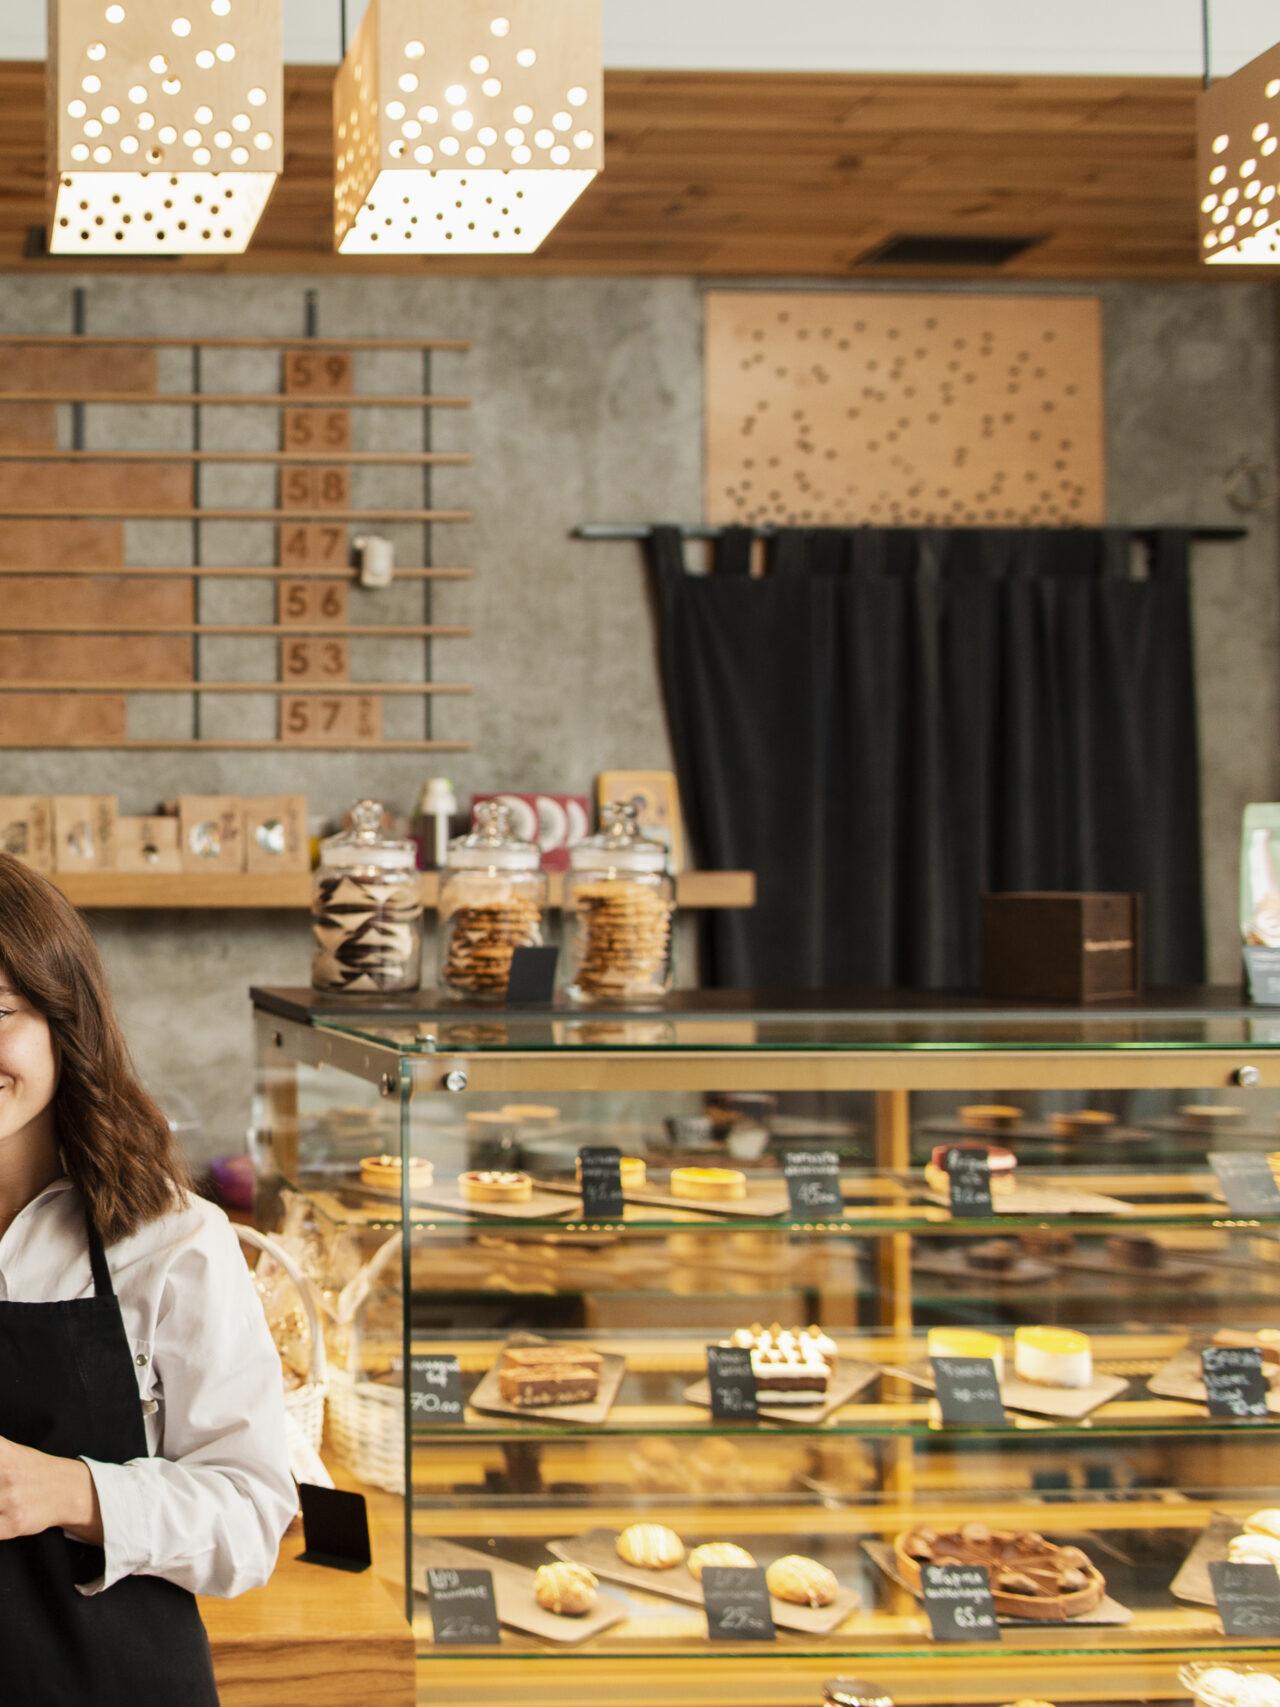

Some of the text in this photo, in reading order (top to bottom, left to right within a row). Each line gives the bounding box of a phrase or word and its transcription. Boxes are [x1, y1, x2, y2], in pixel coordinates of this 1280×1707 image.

[290, 357, 348, 388] 59
[291, 414, 348, 446] 55
[288, 472, 346, 503] 58
[286, 530, 342, 561] 47
[286, 587, 342, 618] 56
[288, 645, 345, 675] 53
[288, 702, 343, 734] 57
